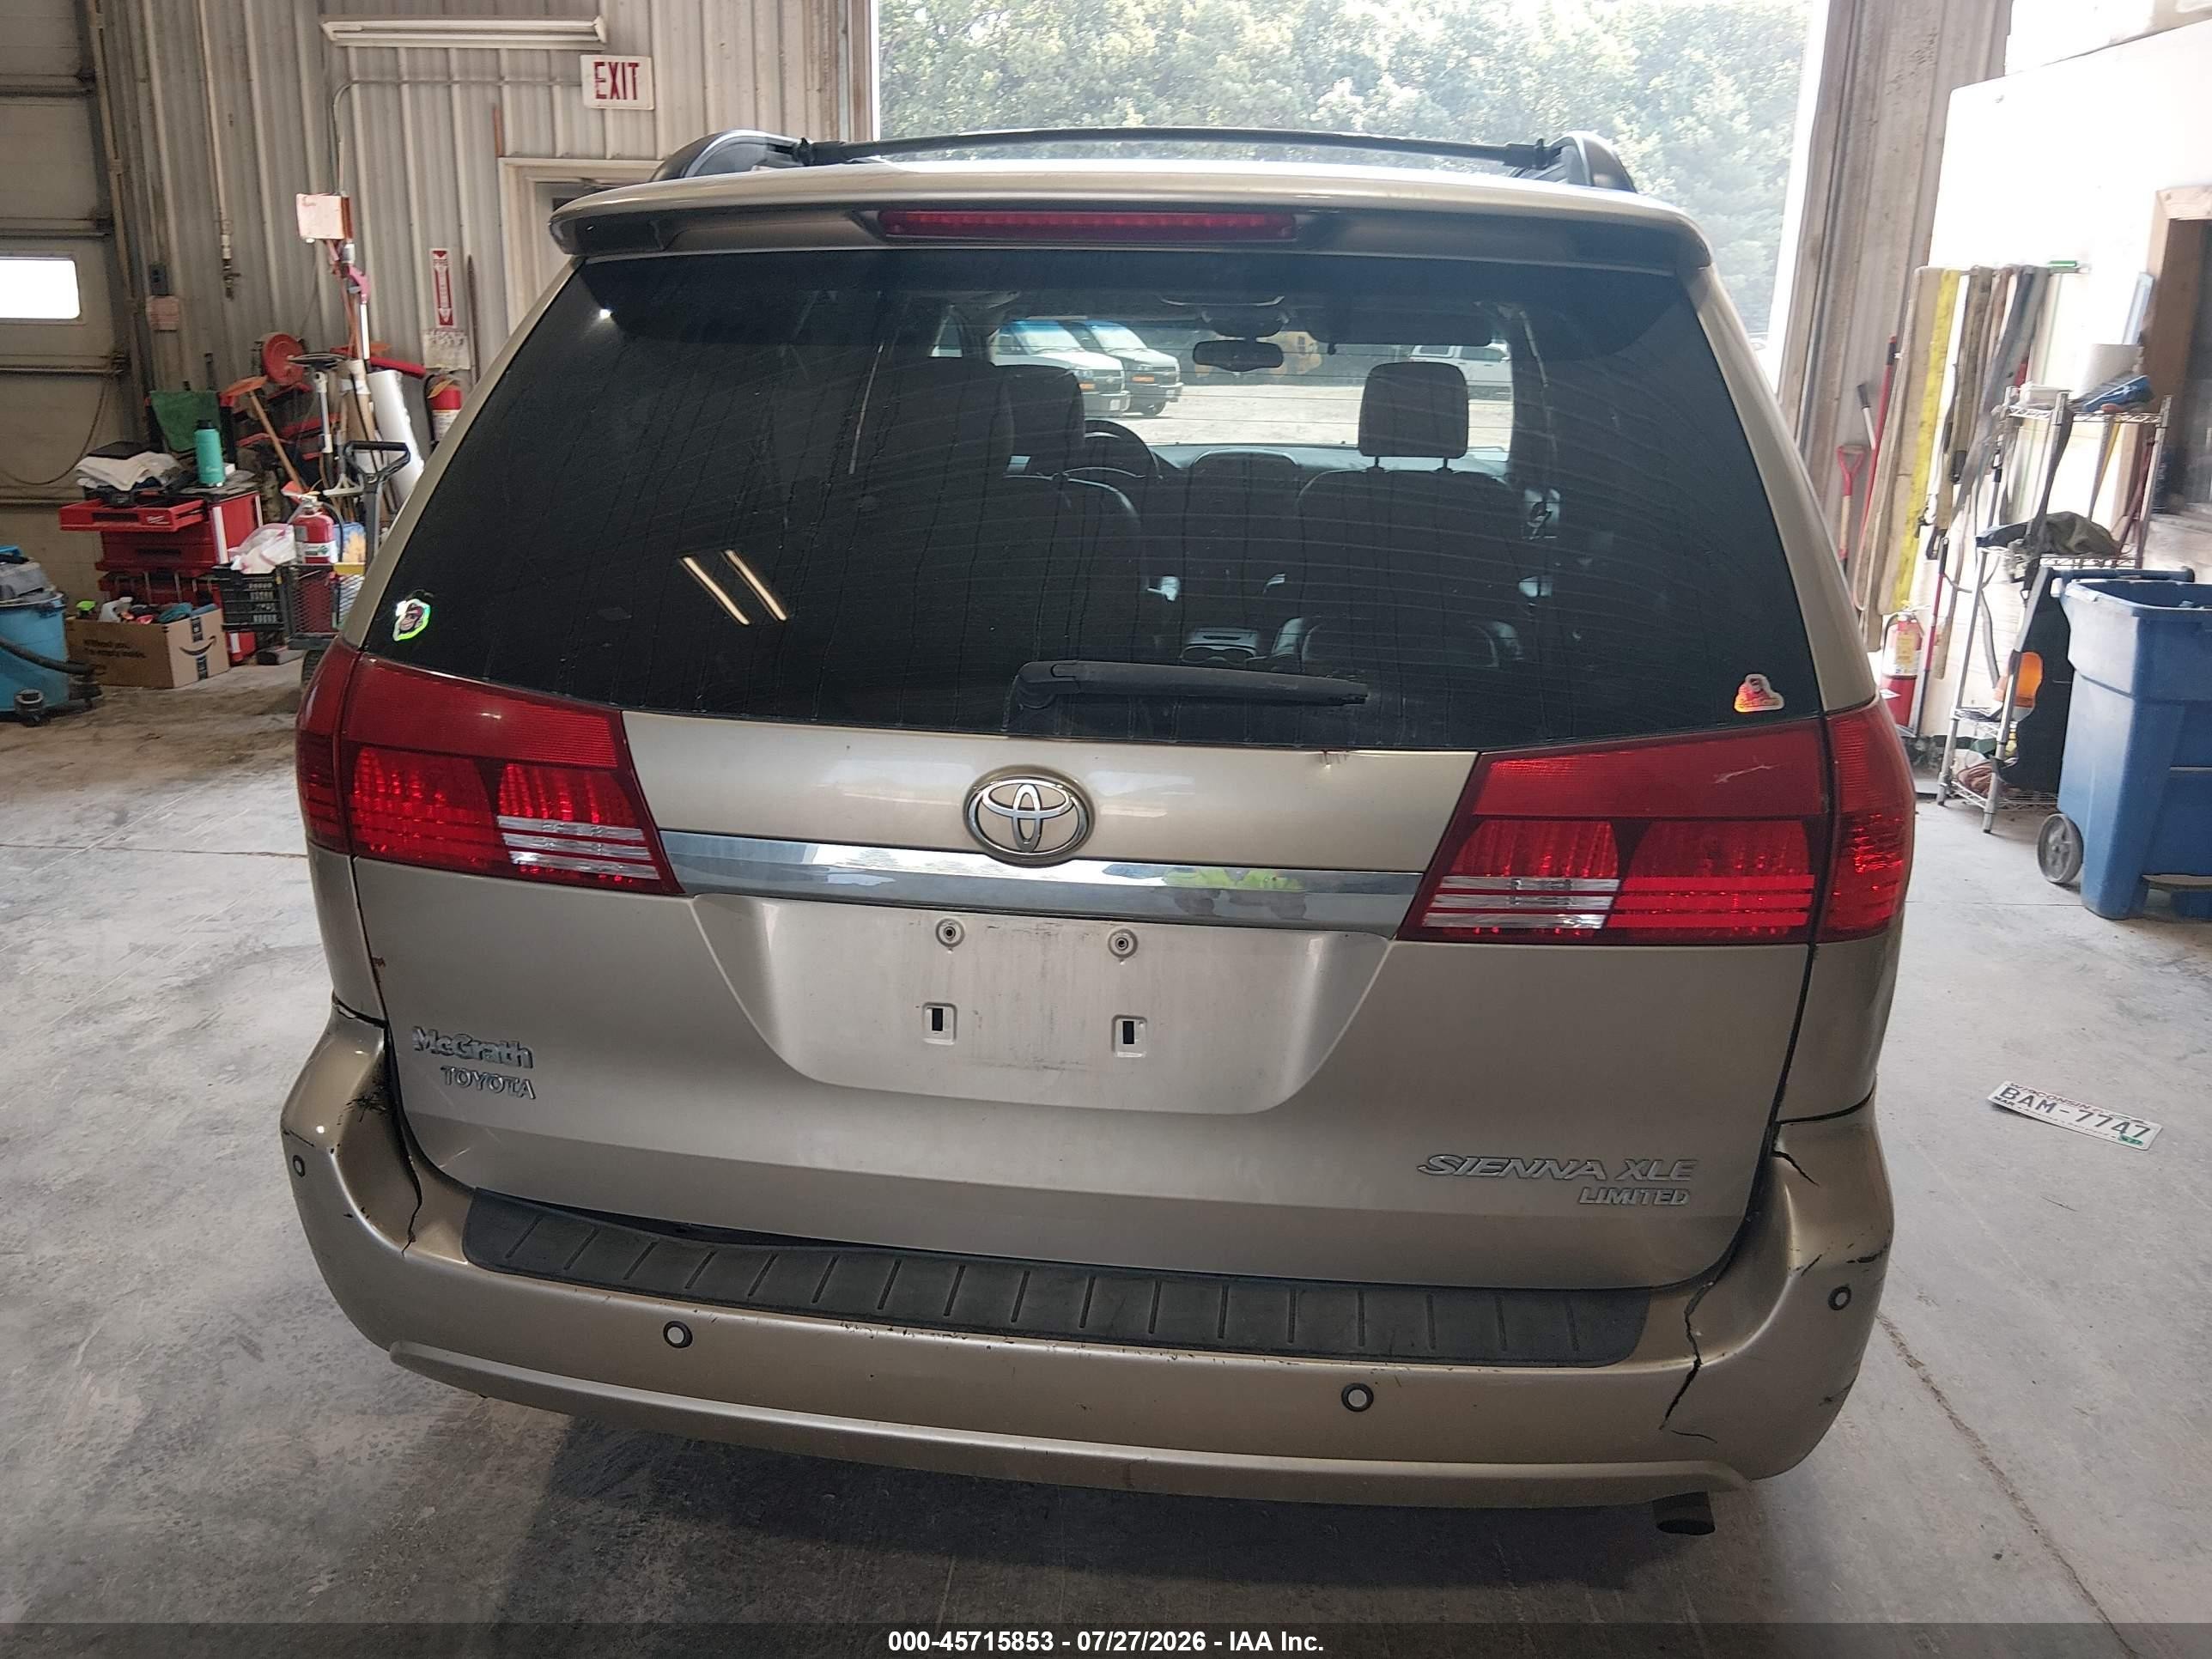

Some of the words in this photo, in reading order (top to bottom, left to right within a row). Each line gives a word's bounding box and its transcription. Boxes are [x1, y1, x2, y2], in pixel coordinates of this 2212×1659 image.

[593, 61, 640, 100] EXIT
[412, 1025, 533, 1069] McGrath
[441, 1065, 537, 1100] TOYOTA
[1999, 1086, 2151, 1139] BAM-7747
[1418, 1154, 1607, 1181] SIENNA
[1614, 1159, 1698, 1182] XLE
[1577, 1186, 1692, 1206] LIMITED
